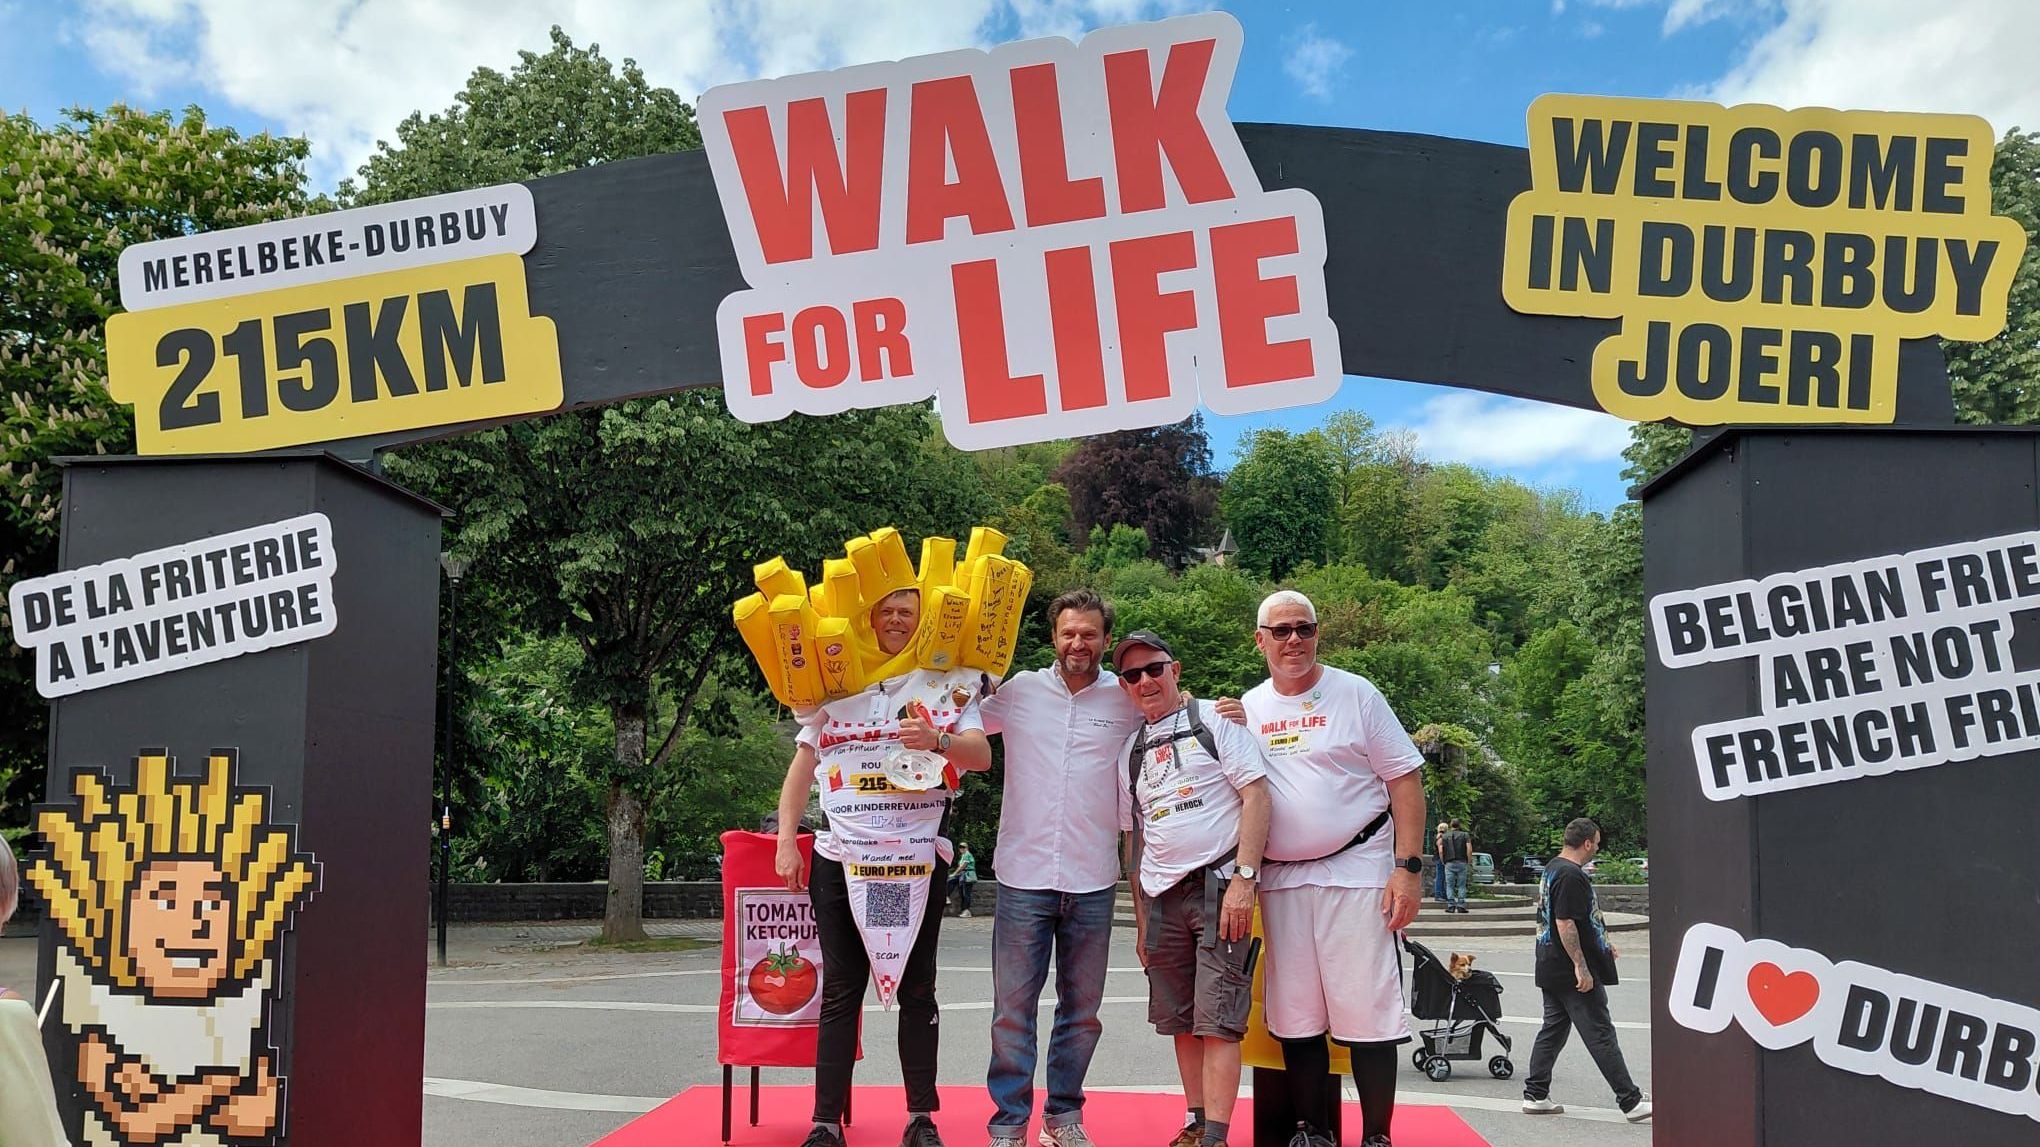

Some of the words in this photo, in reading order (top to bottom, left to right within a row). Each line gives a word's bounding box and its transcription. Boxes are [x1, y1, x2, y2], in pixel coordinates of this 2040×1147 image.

[723, 38, 1236, 265] WALK
[1552, 117, 1968, 215] WELCOME
[143, 203, 510, 294] MERELBEKE-DURBUY
[1527, 215, 1615, 293] IN
[1637, 221, 2000, 316] DURBUY
[156, 282, 505, 432] 215KM
[743, 297, 914, 397] FOR
[952, 215, 1315, 424] LIFE
[1618, 321, 1874, 410] JOERI
[23, 585, 76, 634] DE
[84, 573, 134, 618] LA
[140, 527, 323, 607] FRITERIE
[1663, 567, 1908, 656] BELGIAN
[49, 642, 75, 684] A
[82, 583, 323, 675] L'AVENTURE
[1773, 643, 1882, 708] ARE
[1890, 619, 2002, 688] NOT
[1262, 720, 1287, 735] WALK
[1302, 716, 1326, 727] LIFE
[1706, 701, 1936, 788] FRENCH
[1944, 683, 2040, 749] FRI
[859, 777, 887, 791] 215
[1175, 799, 1204, 812] HEROCK
[860, 866, 885, 876] EURO
[887, 865, 907, 876] PER
[909, 865, 926, 875] KM
[861, 853, 893, 862] Wandel
[898, 853, 916, 861] mee!
[875, 951, 900, 960] scan
[1693, 946, 1723, 1010] I
[1838, 984, 2040, 1093] DURB
